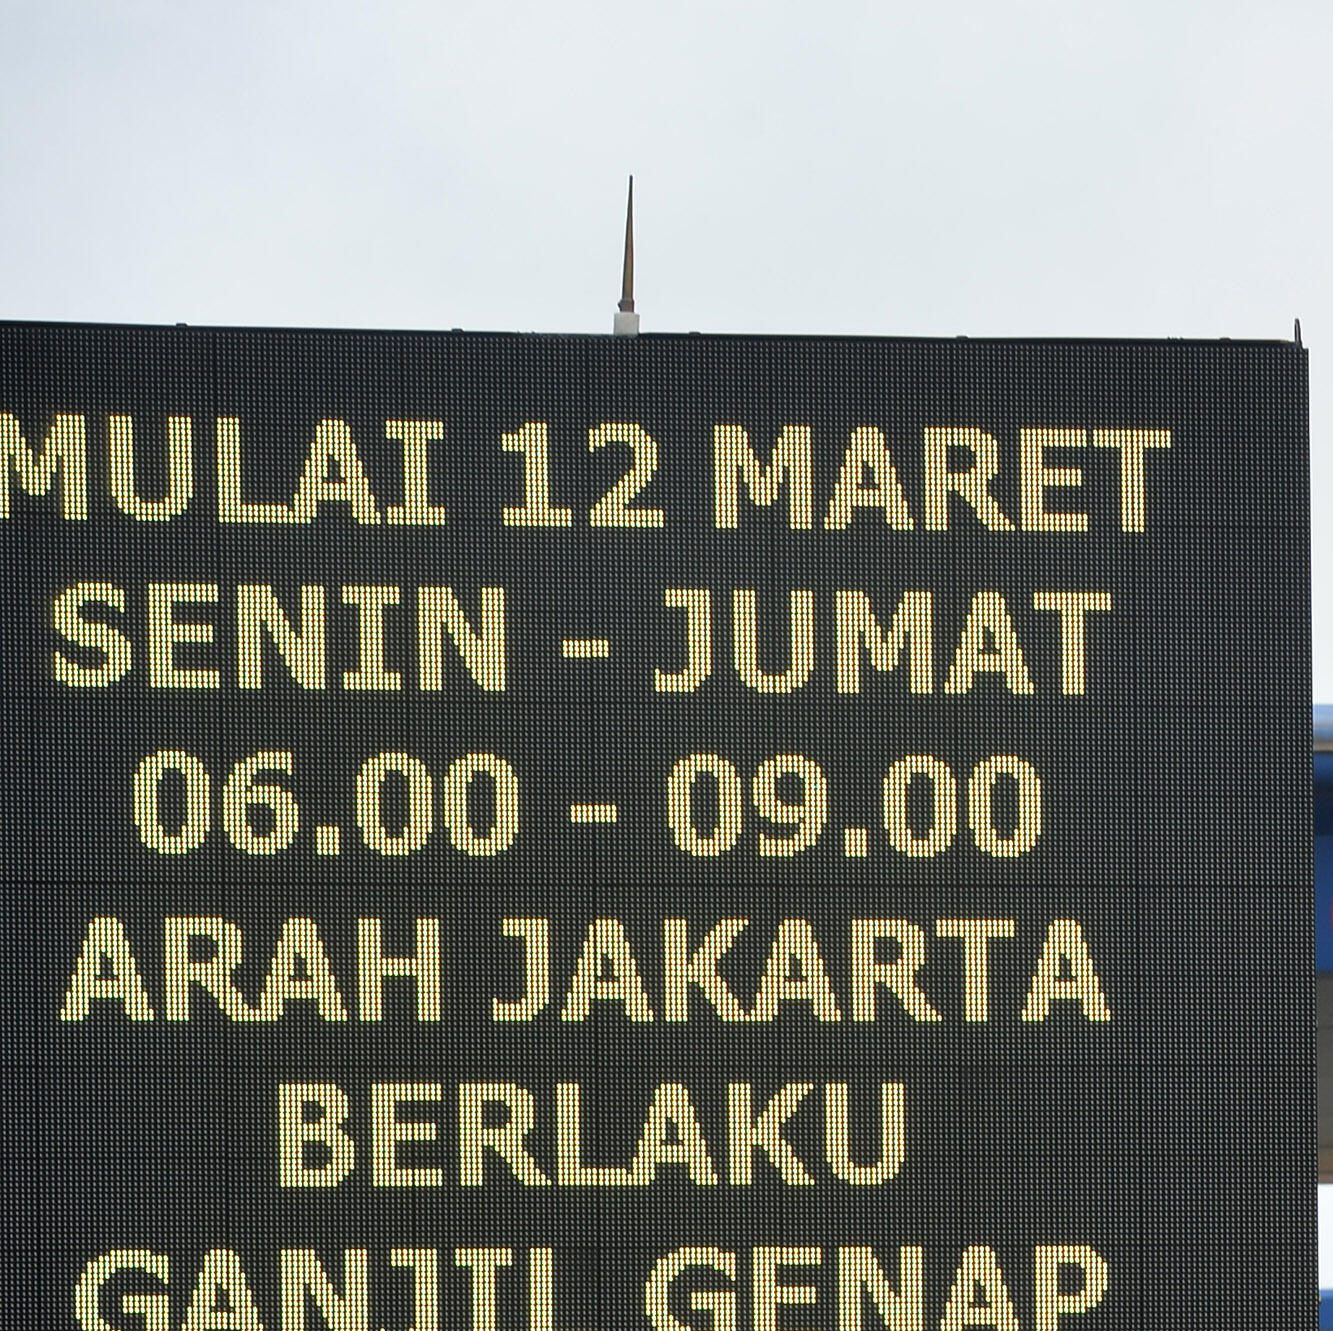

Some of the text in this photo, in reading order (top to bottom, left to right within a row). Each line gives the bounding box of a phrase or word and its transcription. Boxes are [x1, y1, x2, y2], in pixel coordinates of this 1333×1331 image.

[0, 414, 1171, 533] MULAI 12 MARET
[52, 582, 1112, 696] SENIN - JUMAT
[132, 750, 1043, 858] 06.00 - 09.00
[60, 917, 1112, 1023] ARAH JAKARTA
[277, 1082, 905, 1188] BERLAKU
